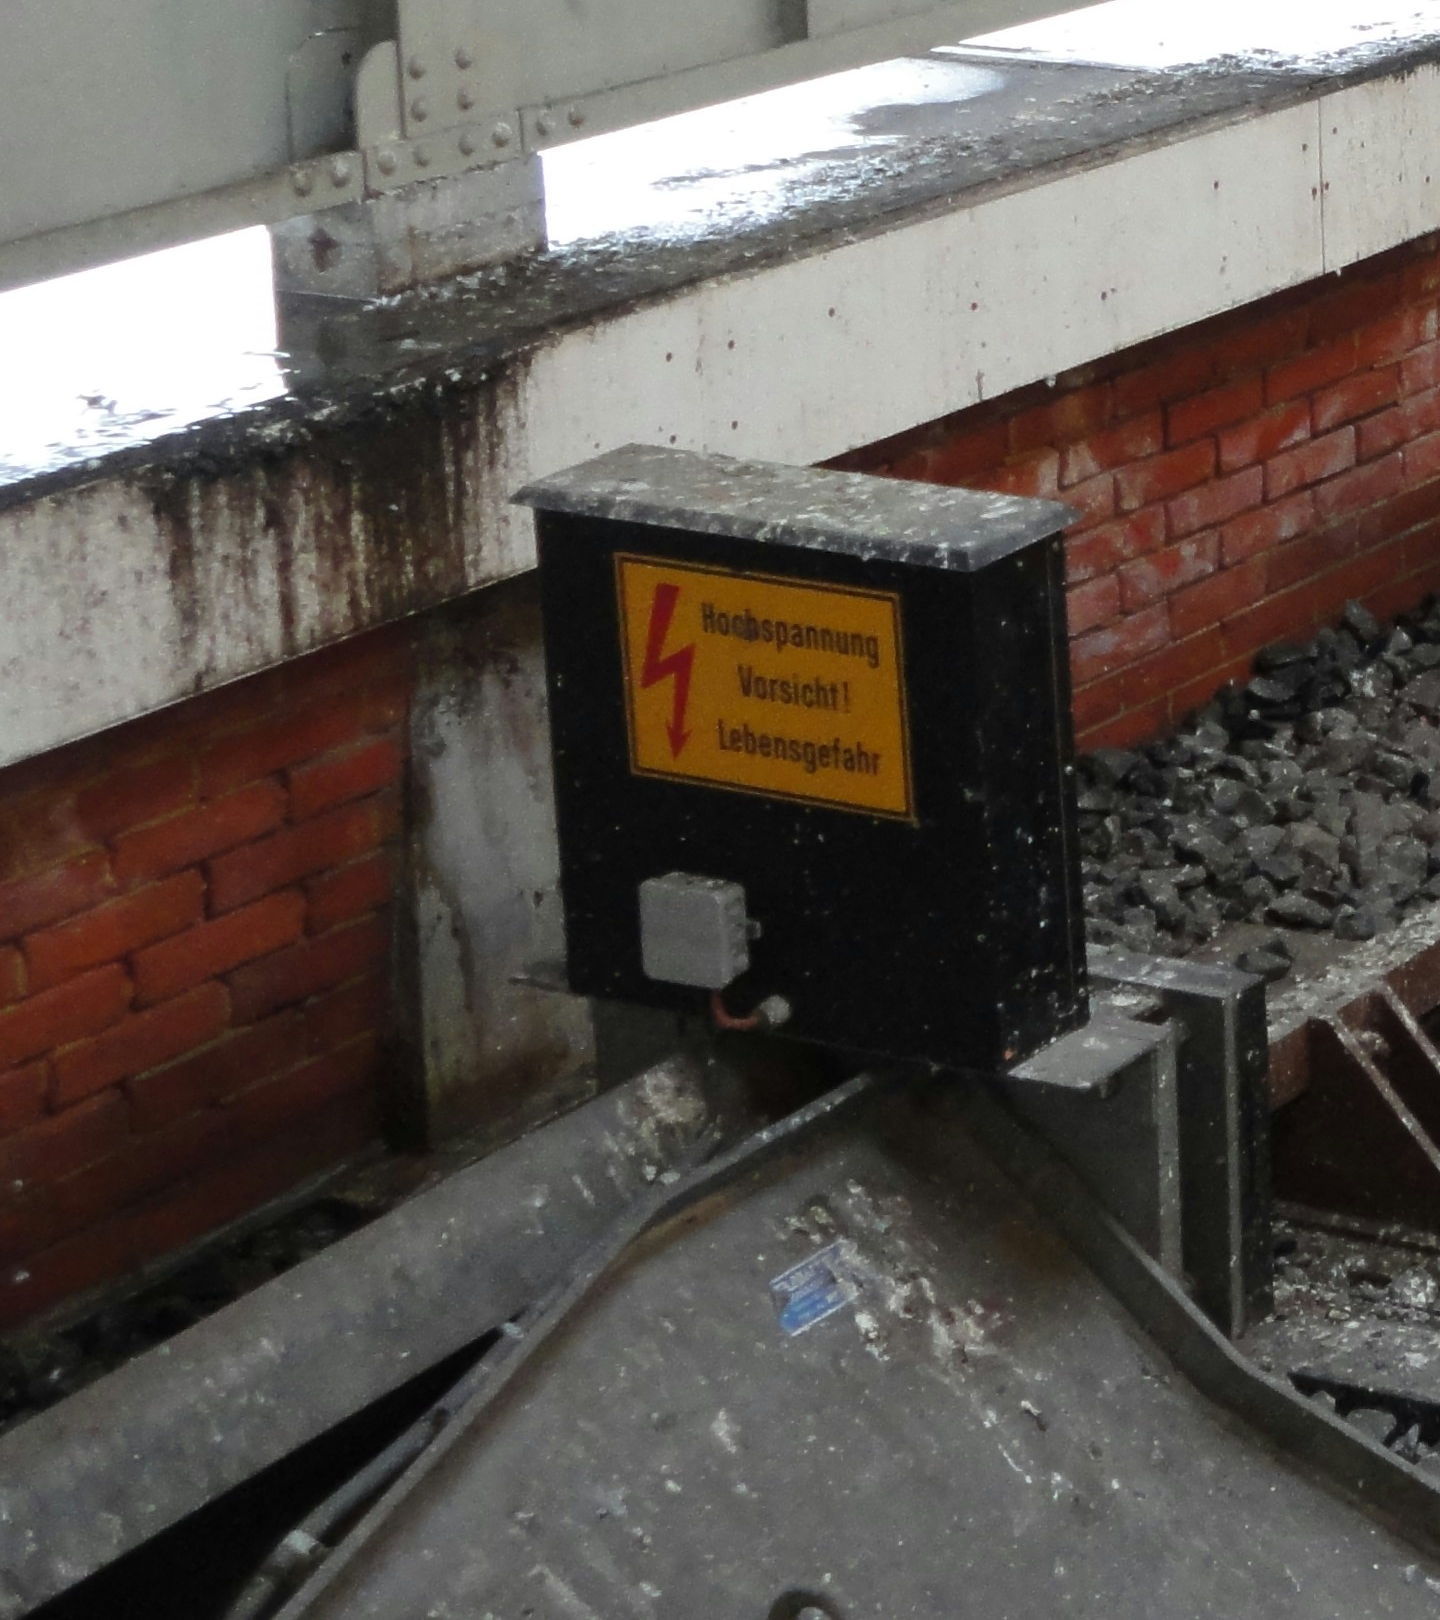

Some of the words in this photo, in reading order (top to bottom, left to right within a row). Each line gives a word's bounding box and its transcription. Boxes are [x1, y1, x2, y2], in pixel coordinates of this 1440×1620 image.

[700, 602, 880, 669] Hochspannung
[736, 664, 851, 715] Vorsicht!
[716, 720, 882, 776] Lebensgefahr
